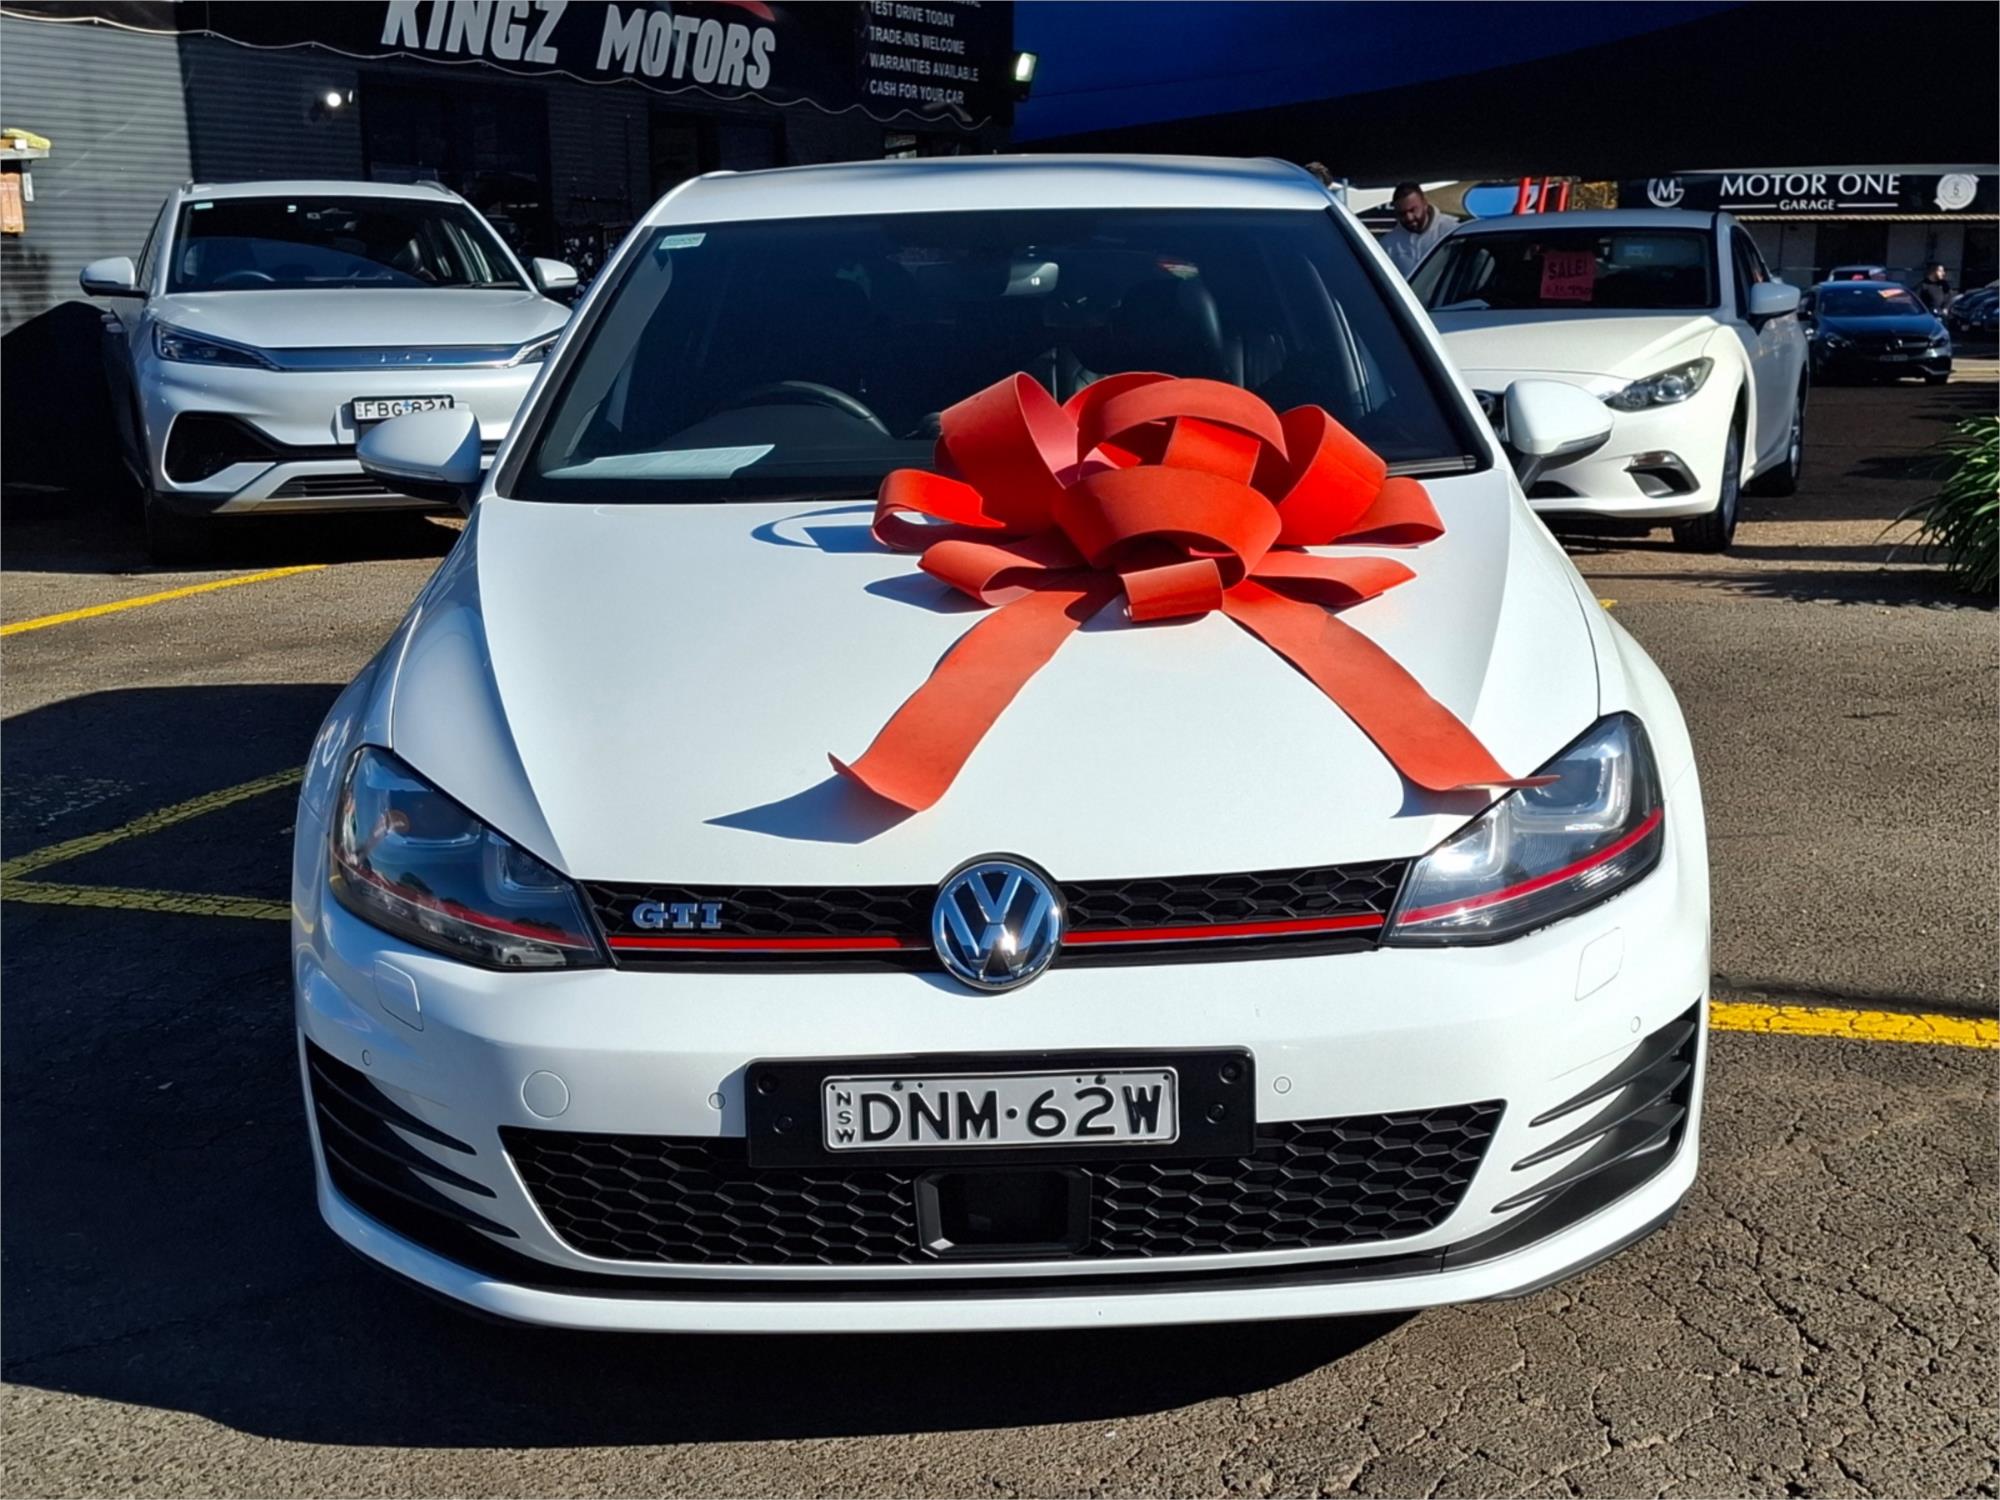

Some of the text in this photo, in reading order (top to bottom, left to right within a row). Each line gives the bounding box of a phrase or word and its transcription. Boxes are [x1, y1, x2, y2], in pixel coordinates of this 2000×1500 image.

[869, 0, 955, 27] TEST DRIVE TODAY
[381, 0, 776, 89] KINGZ MOTORS
[869, 26, 965, 55] TRADE-INS WELCOME
[869, 53, 979, 81] WARRANTIES AVAILABLE
[869, 80, 964, 104] CASH FOR YOUR CAR
[1720, 174, 1900, 197] MOTOR ONE
[1779, 198, 1835, 212] GARAGE
[632, 901, 722, 929] GTI
